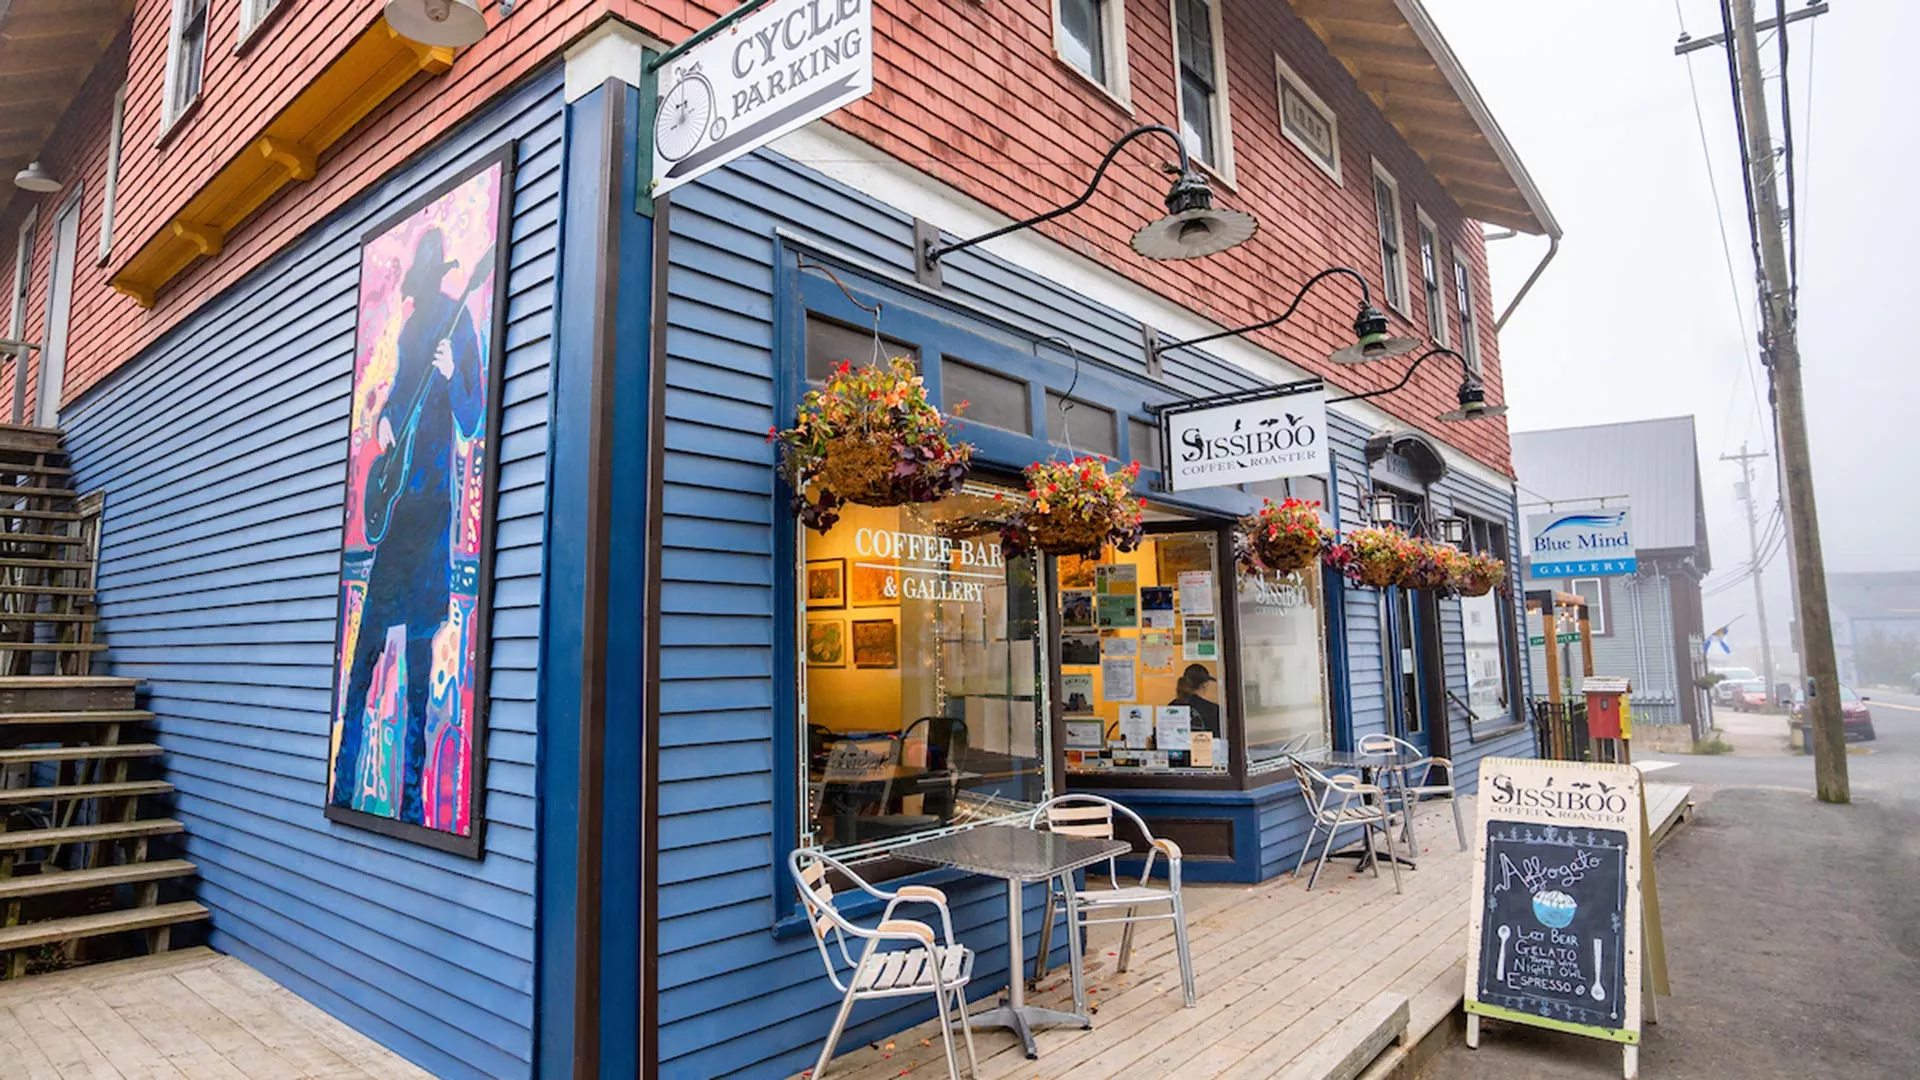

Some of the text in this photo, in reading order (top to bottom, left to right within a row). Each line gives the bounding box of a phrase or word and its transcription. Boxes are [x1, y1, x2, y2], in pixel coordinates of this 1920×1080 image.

[732, 0, 861, 79] CYCLE
[732, 28, 862, 120] PARKING
[1181, 425, 1315, 462] SISSIBOO
[1182, 450, 1317, 476] COFFEE ROASTER
[855, 528, 1004, 567] COFFEE BAR
[1533, 531, 1629, 552] Blue Mind
[1539, 560, 1627, 575] GALLERY
[883, 575, 985, 601] & GALLERY
[1491, 774, 1627, 813] SISSIBOO
[1490, 806, 1625, 823] COFFEE ROASTER
[1494, 849, 1602, 893] Affogato
[1515, 939, 1577, 961] GELATO
[1513, 958, 1555, 976] NIGHT
[1507, 972, 1572, 993] ESPRESSO
